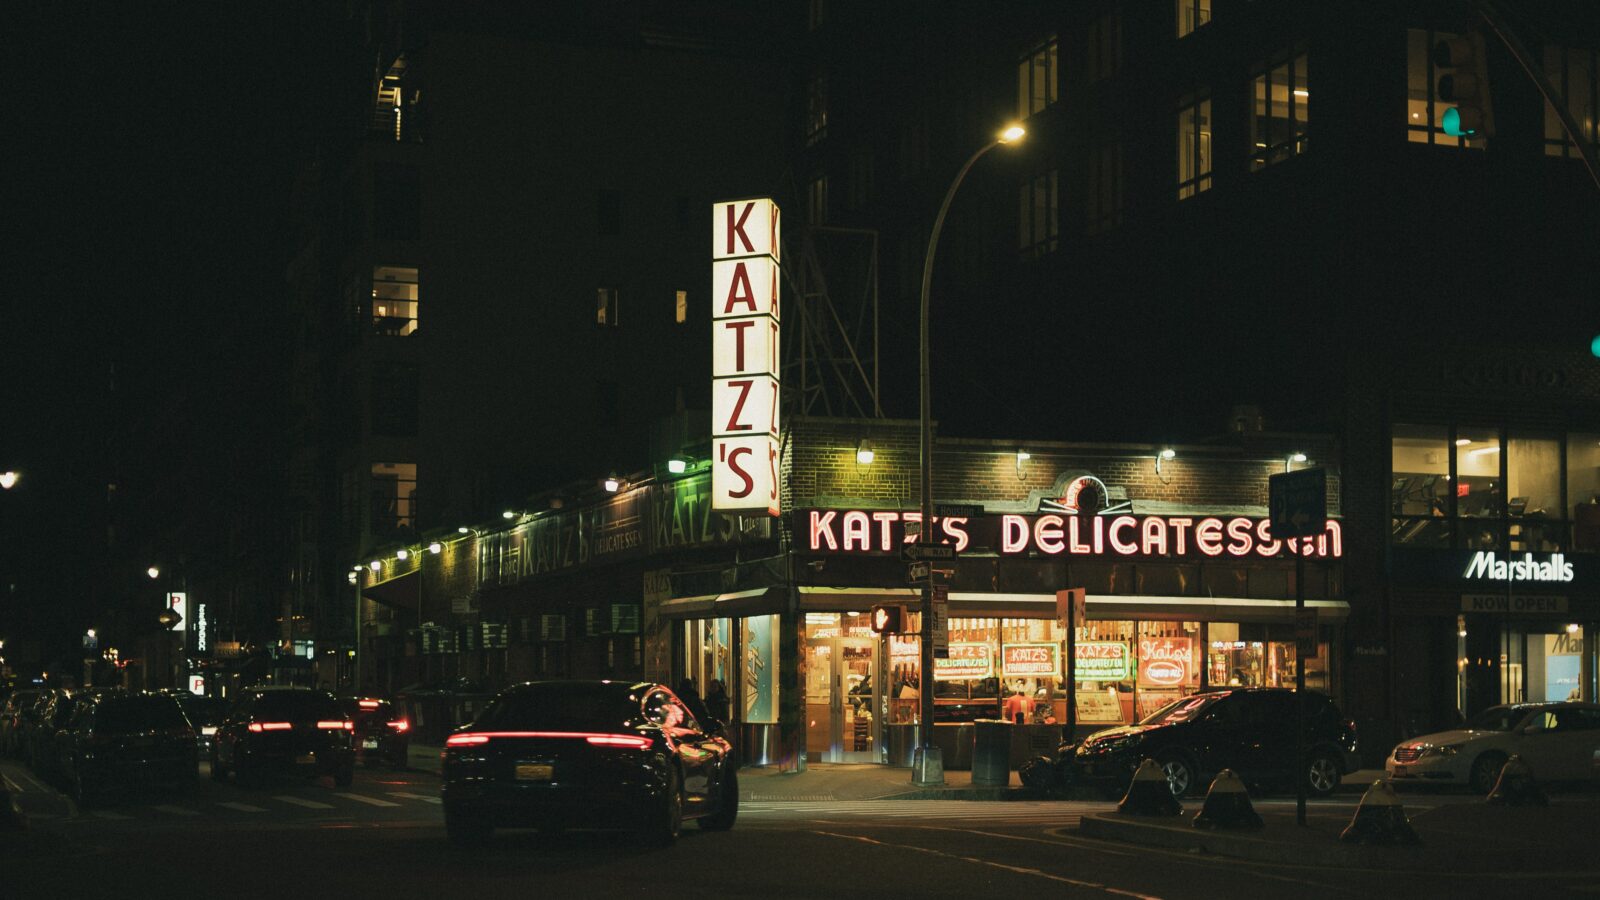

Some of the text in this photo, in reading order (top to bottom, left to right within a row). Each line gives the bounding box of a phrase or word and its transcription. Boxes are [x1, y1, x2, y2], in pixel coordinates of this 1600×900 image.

[720, 202, 757, 499] KATZ'S
[768, 204, 778, 501] KATZ'S
[1463, 550, 1575, 582] Marshalls
[171, 596, 181, 608] P
[1472, 597, 1558, 611] NOW OPEN
[1013, 648, 1048, 661] KATZ'S
[1076, 645, 1122, 658] KATZ'S
[194, 679, 204, 690] P
